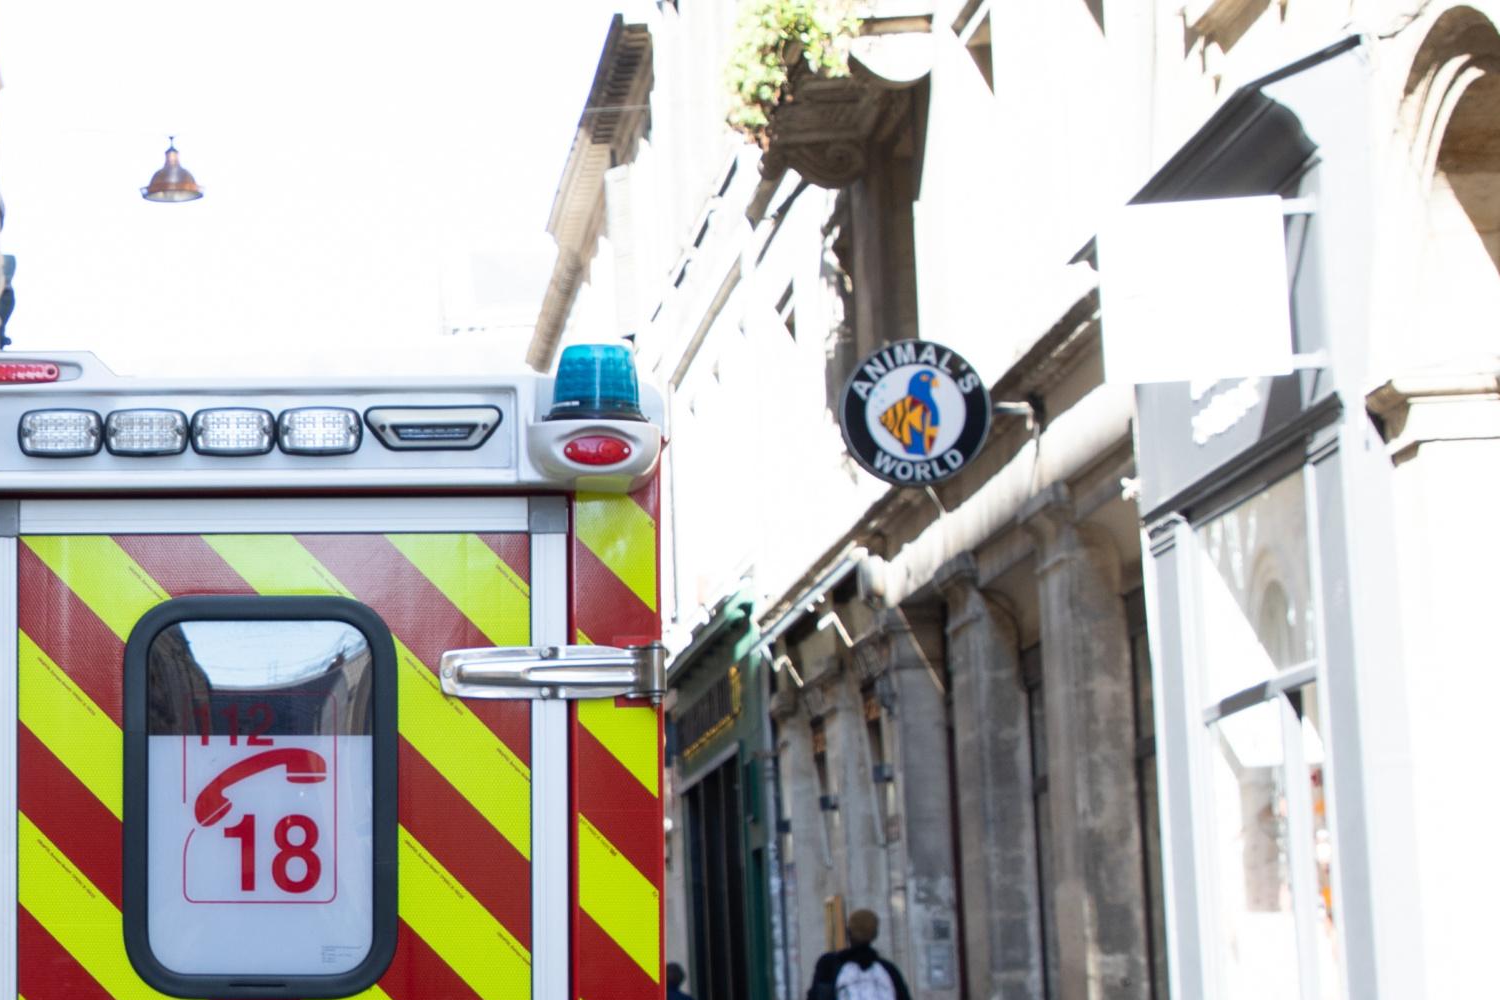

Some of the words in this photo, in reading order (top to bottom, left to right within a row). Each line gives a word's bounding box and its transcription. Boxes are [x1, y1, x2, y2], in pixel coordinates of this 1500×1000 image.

[851, 342, 980, 400] ANIMAL'S
[873, 449, 964, 481] WORLD
[193, 702, 275, 746] 112
[224, 814, 322, 894] 18
